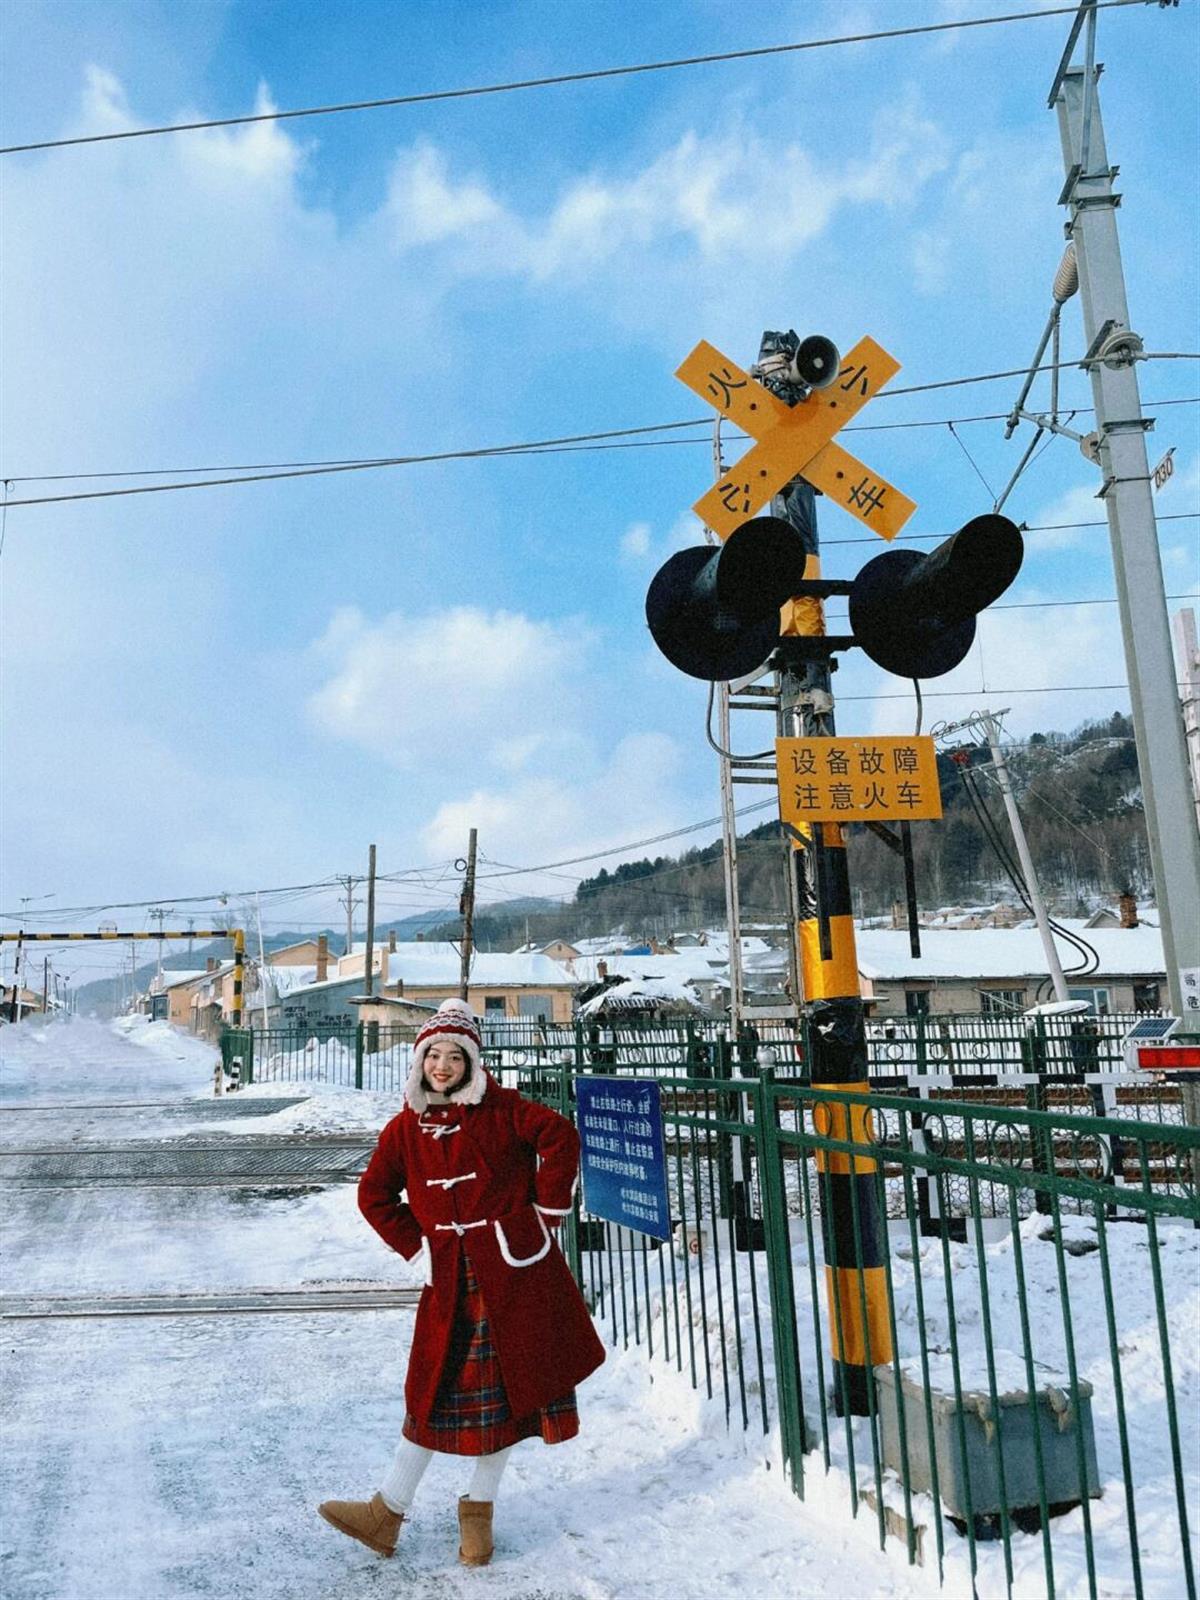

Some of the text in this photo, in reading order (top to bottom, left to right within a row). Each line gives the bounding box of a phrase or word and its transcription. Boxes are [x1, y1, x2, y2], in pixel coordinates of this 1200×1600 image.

[708, 368, 886, 516] 火 车
[719, 366, 867, 513] 小 心
[1155, 456, 1173, 489] 030
[791, 746, 919, 775] 设备故障
[793, 781, 922, 810] 注意火车
